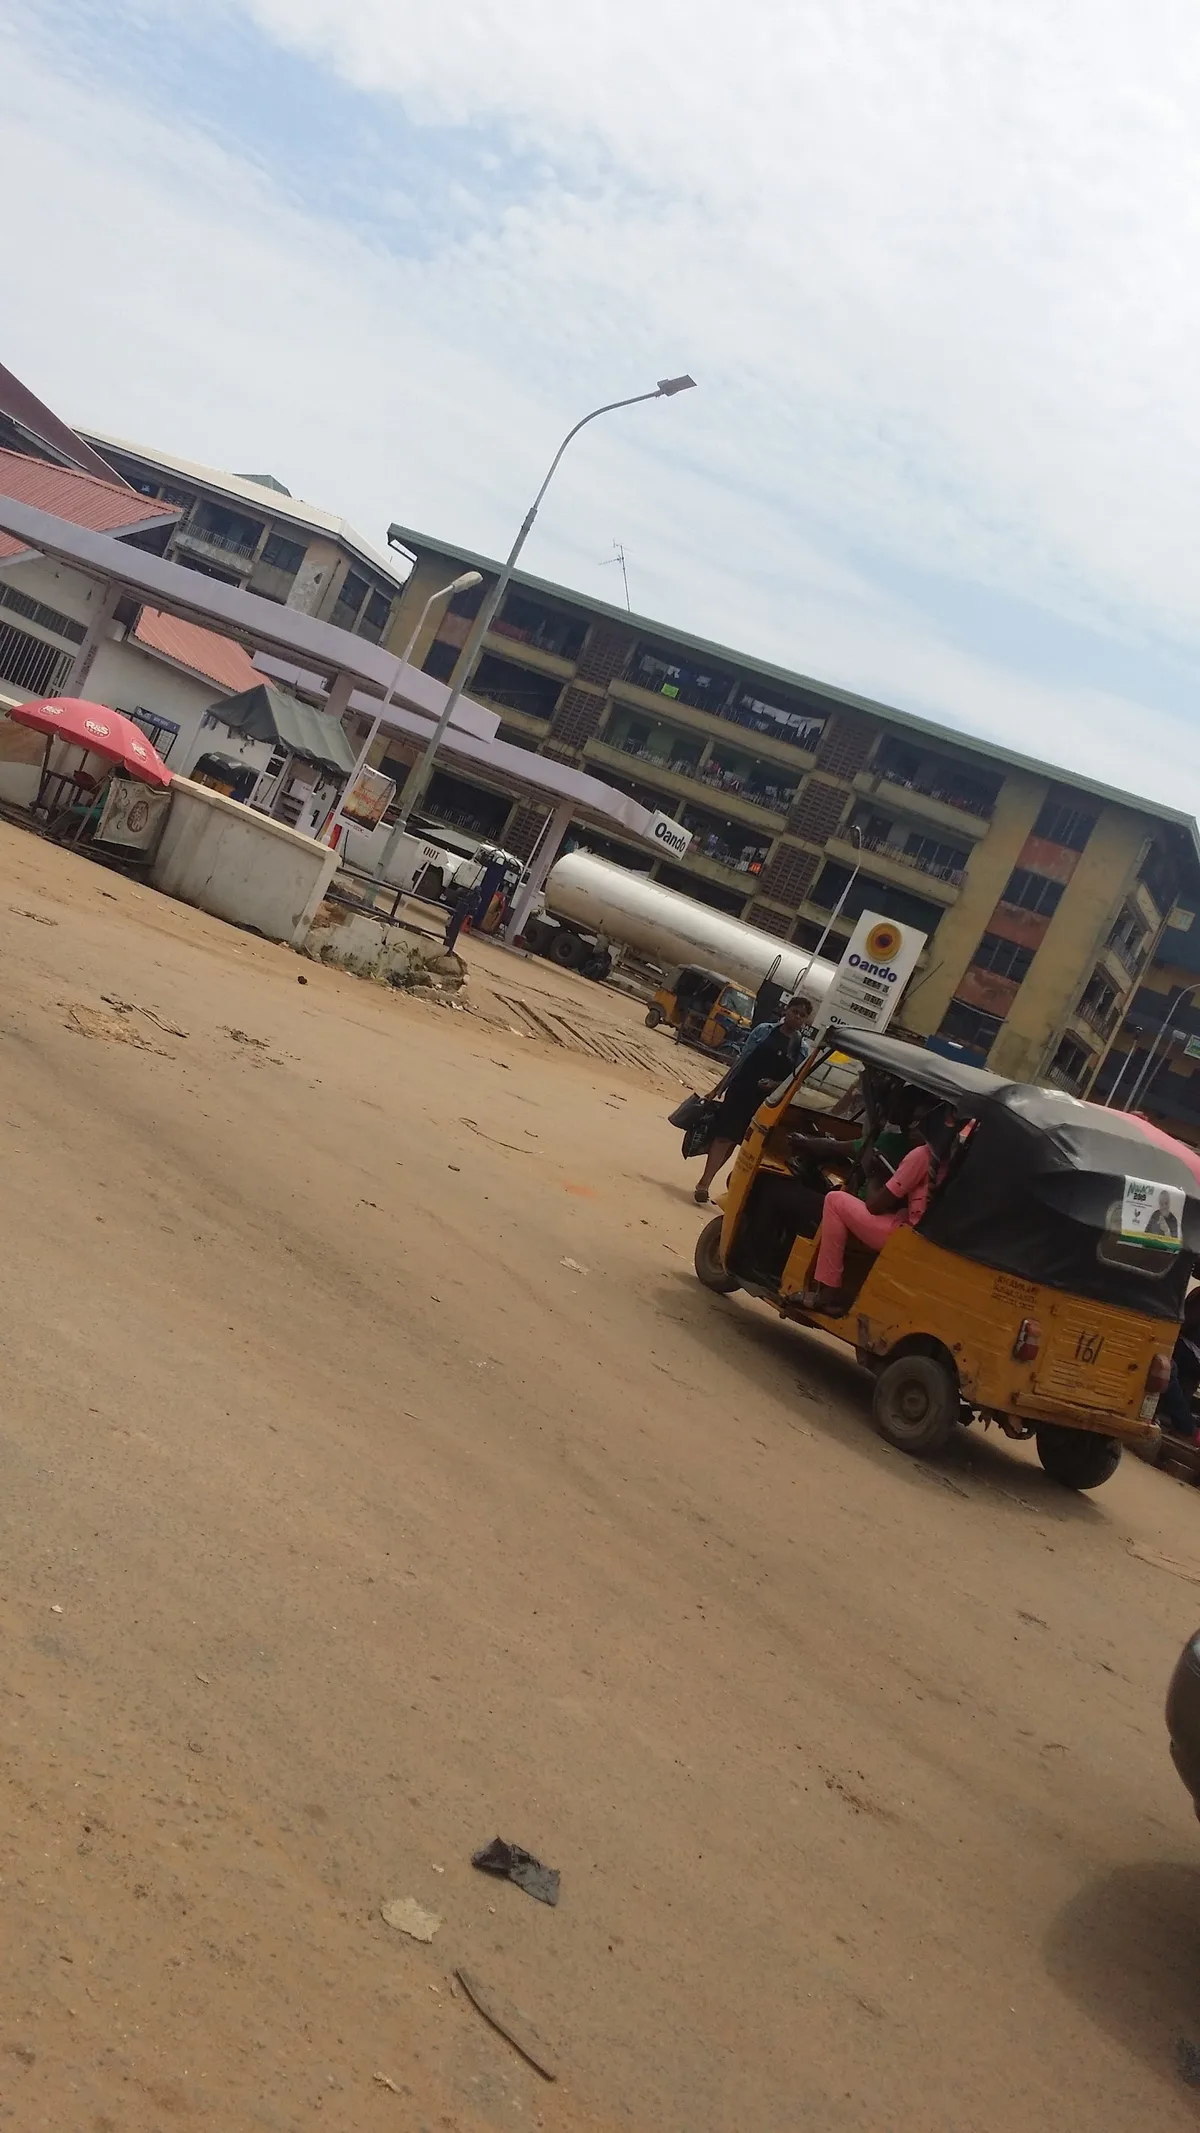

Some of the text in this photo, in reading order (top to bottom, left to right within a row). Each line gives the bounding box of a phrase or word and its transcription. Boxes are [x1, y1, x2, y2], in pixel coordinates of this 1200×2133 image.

[85, 720, 109, 735] R&S
[655, 822, 686, 852] Oando
[423, 846, 440, 860] OUT
[848, 954, 897, 982] Oando
[1075, 1330, 1105, 1365] 161
